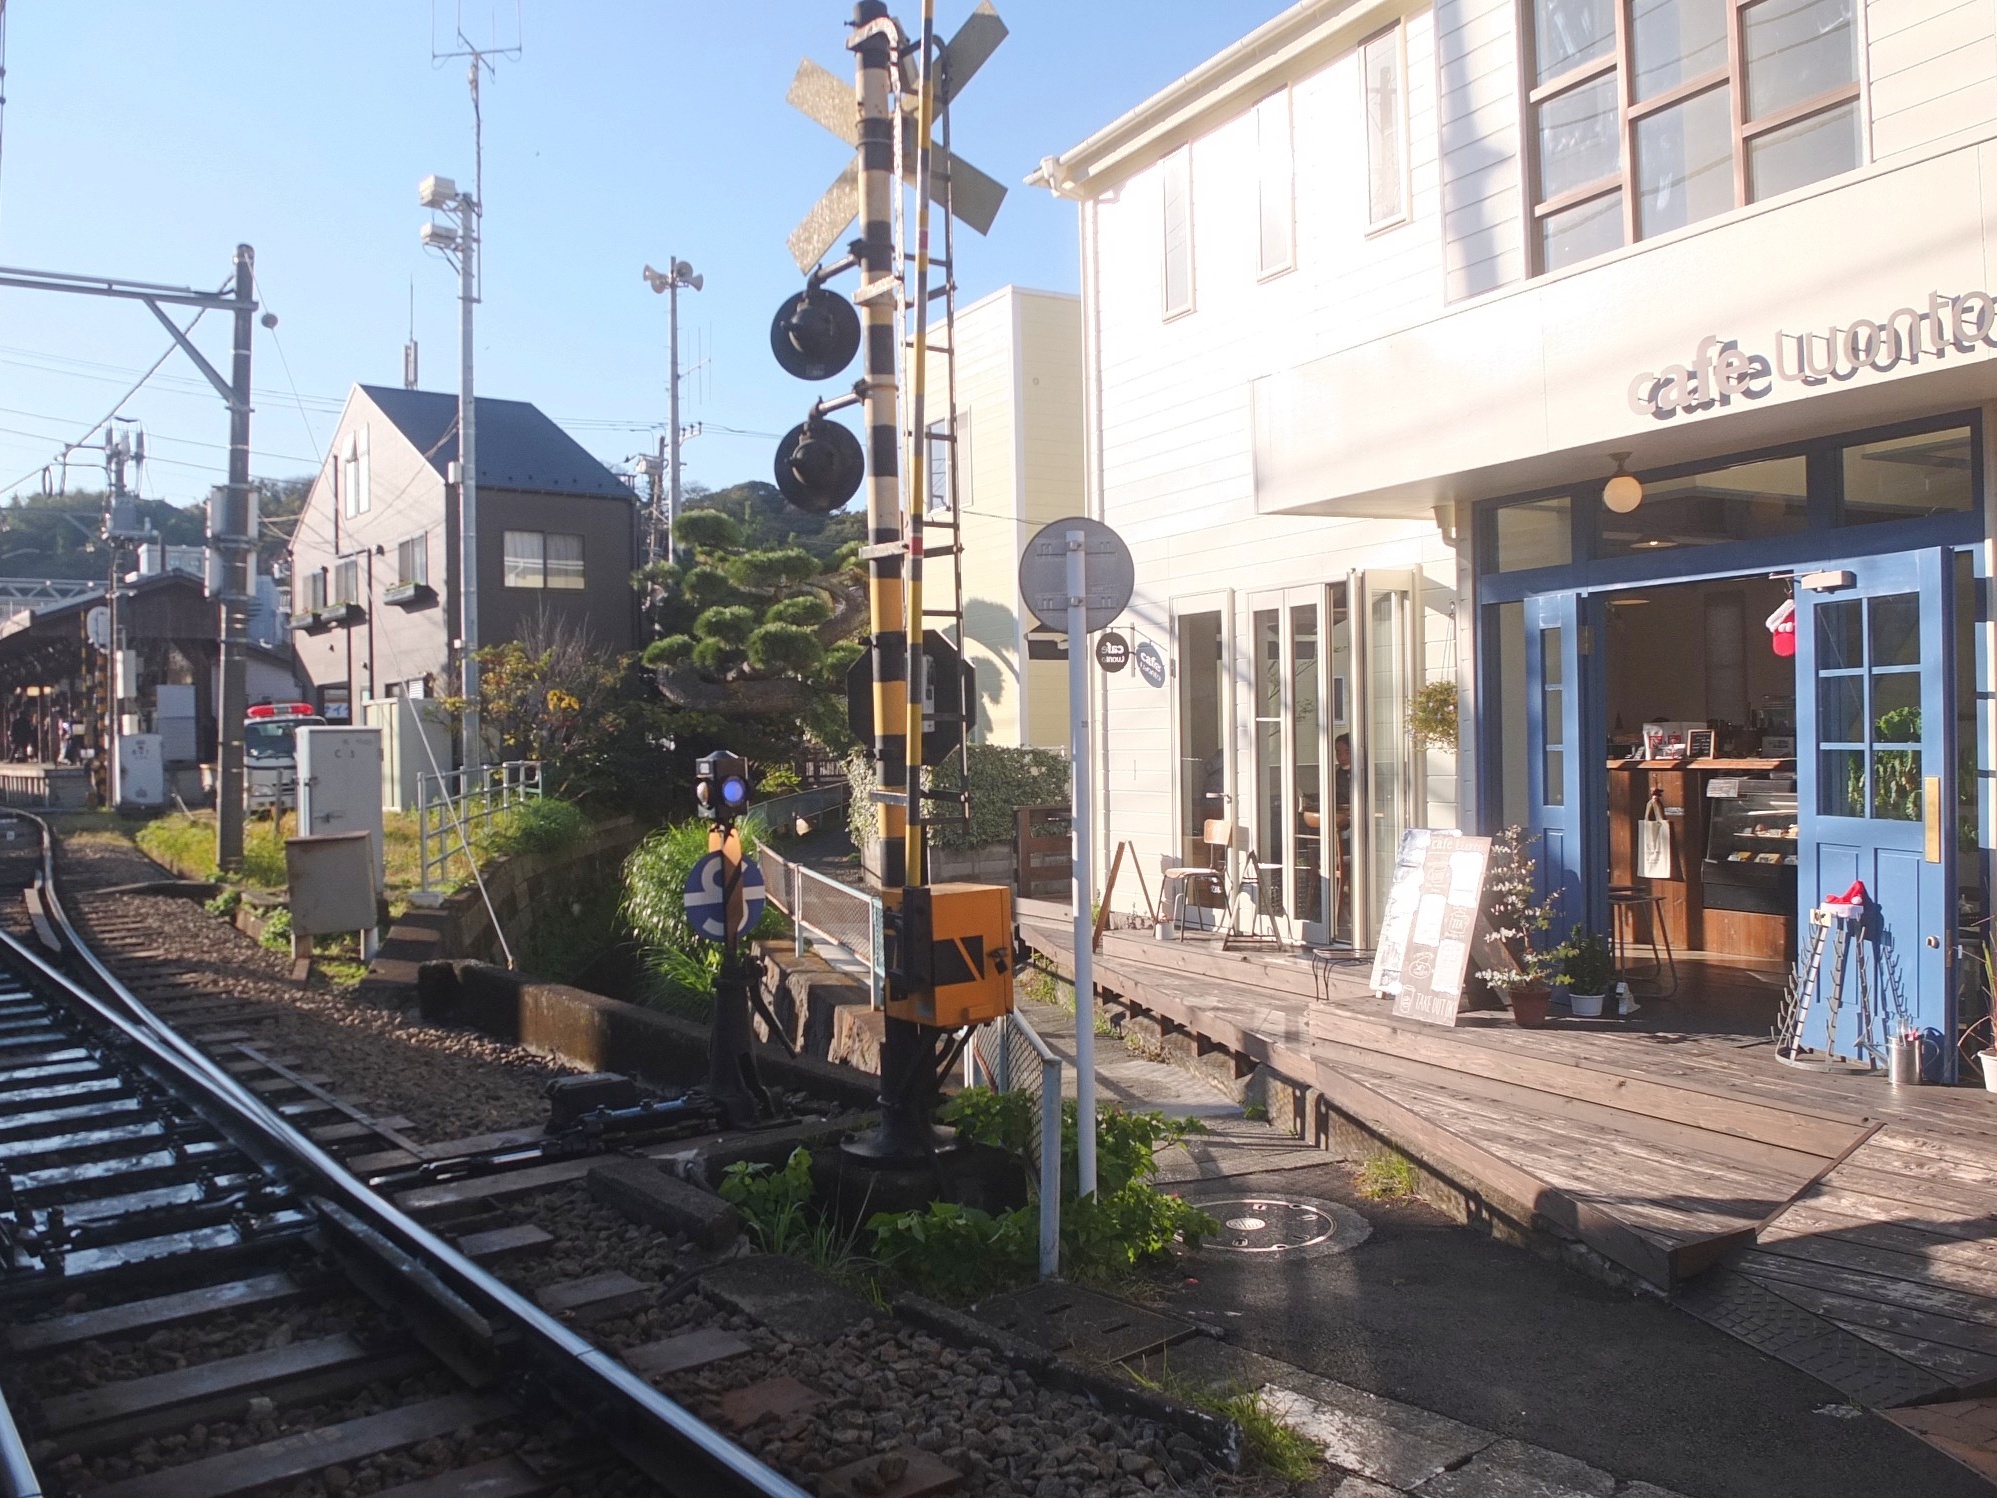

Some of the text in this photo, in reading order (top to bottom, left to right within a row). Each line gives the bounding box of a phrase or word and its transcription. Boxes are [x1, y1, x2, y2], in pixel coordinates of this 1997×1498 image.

[1627, 334, 1751, 416] cafe
[1140, 652, 1162, 672] cafe
[1431, 837, 1453, 850] cafe
[1415, 992, 1433, 1013] TAKE
[1431, 997, 1446, 1016] OUT
